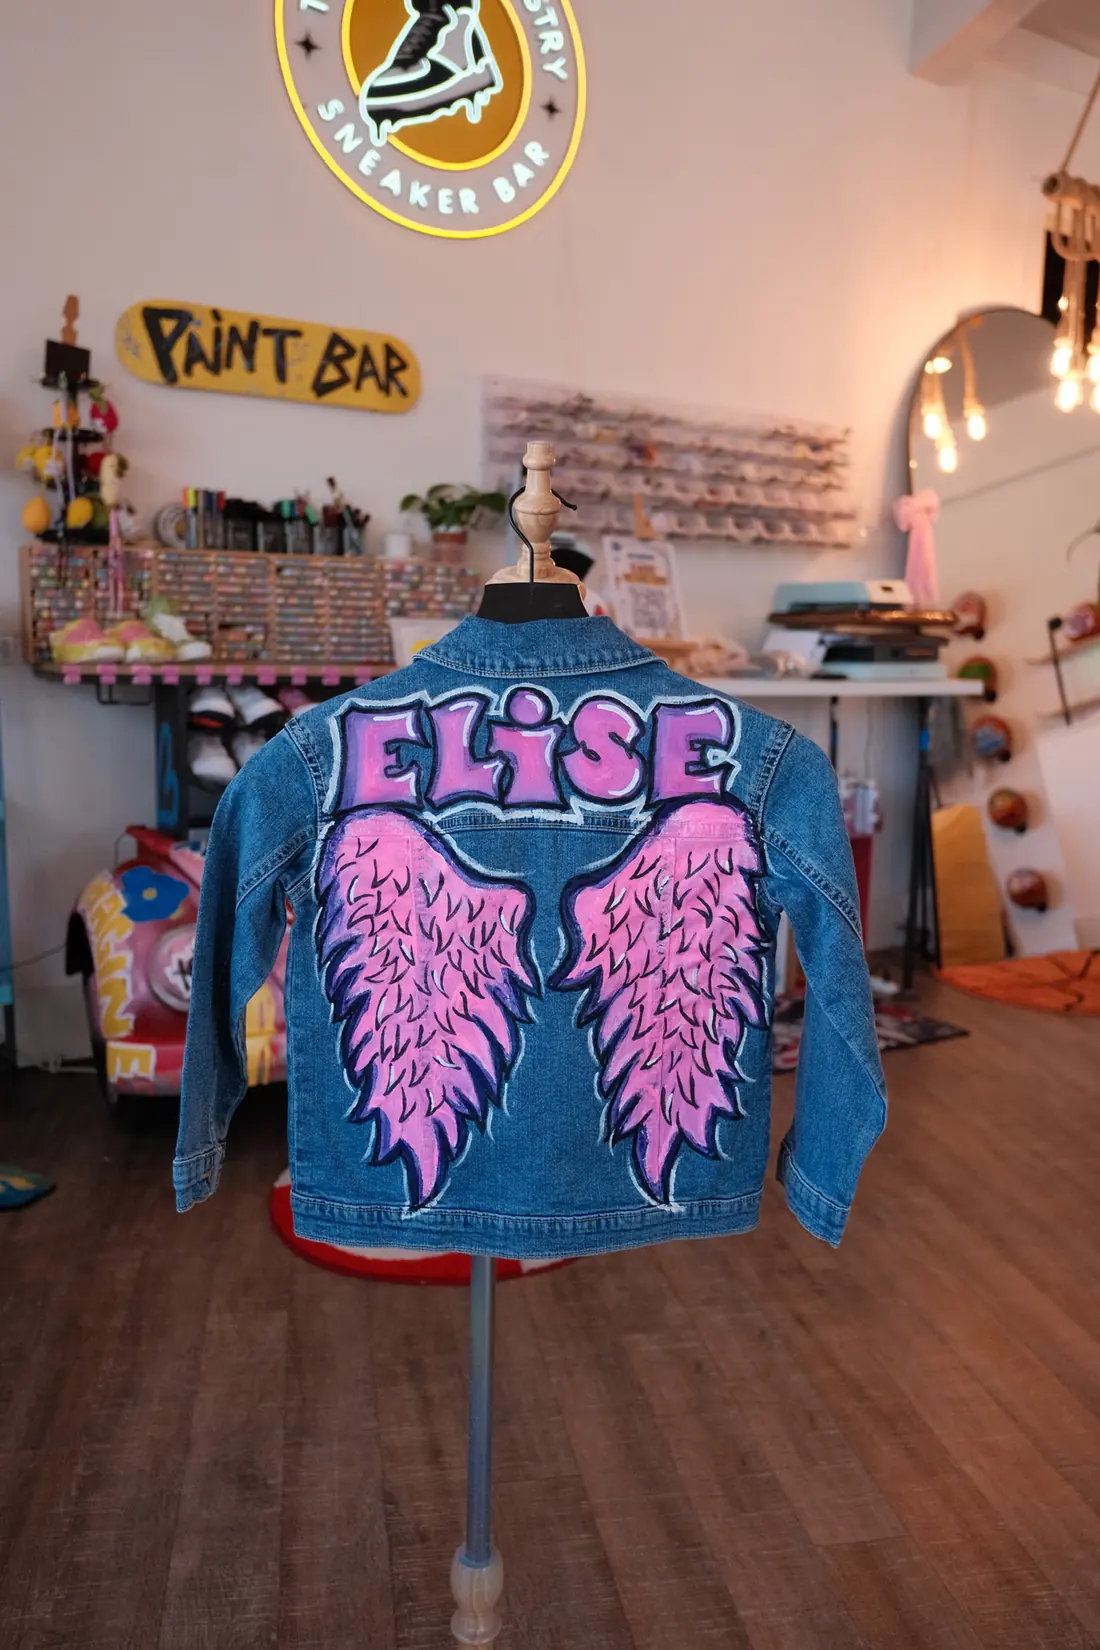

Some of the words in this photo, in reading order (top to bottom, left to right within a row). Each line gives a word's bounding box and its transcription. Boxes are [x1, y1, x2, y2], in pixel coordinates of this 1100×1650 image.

[317, 98, 479, 214] SNEAKER
[492, 140, 549, 203] BAR
[311, 331, 409, 398] BAR
